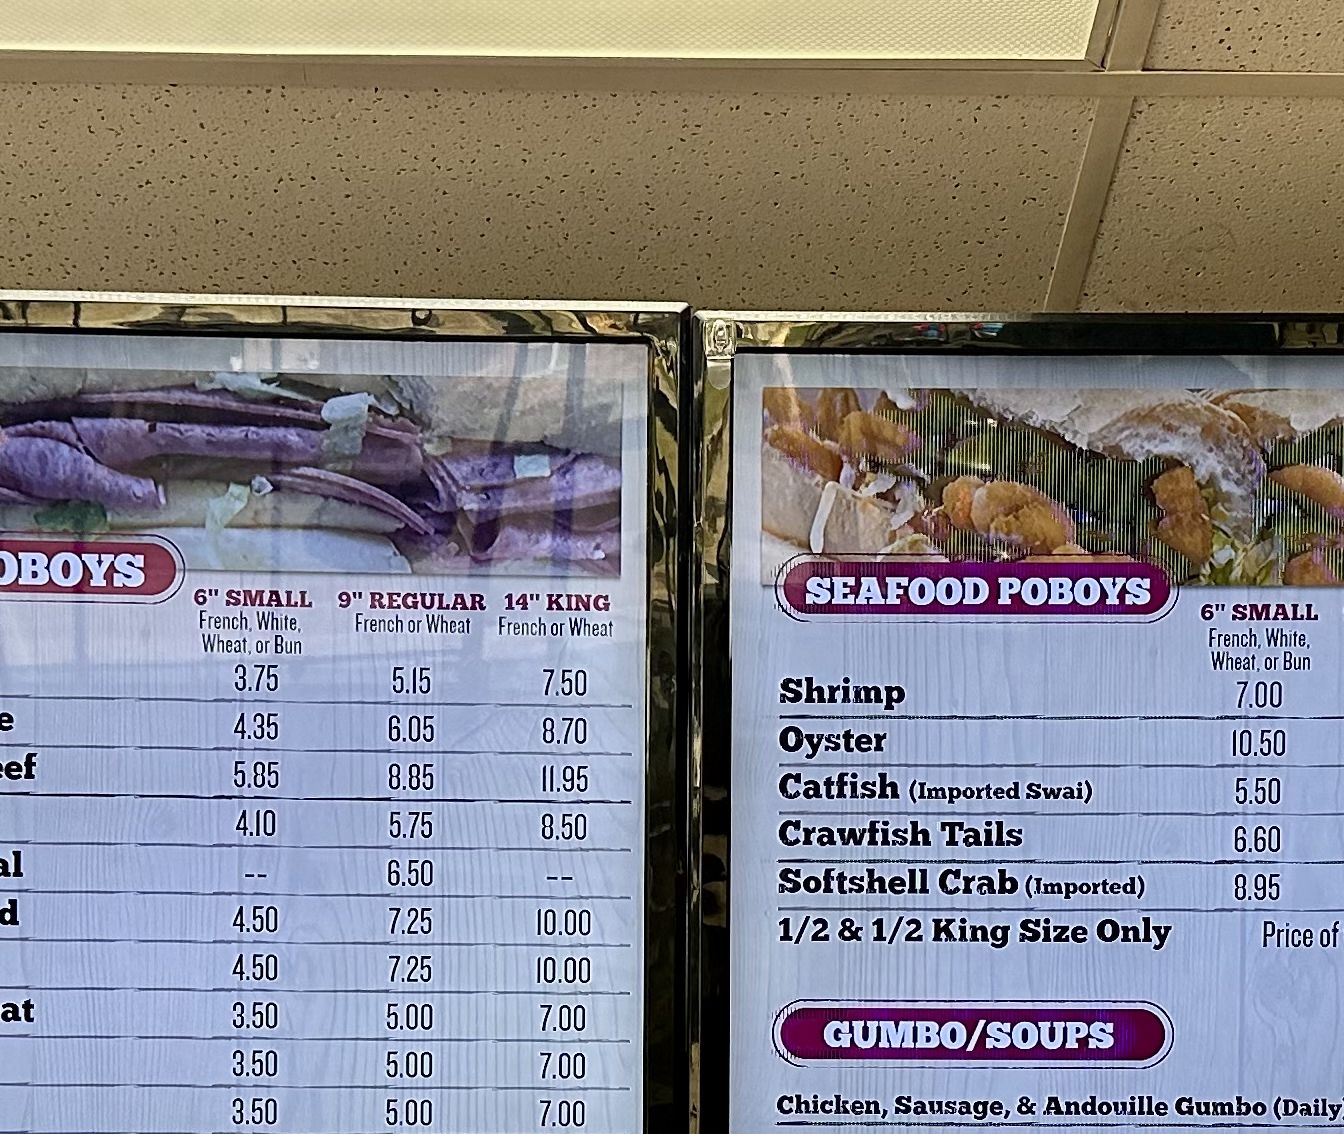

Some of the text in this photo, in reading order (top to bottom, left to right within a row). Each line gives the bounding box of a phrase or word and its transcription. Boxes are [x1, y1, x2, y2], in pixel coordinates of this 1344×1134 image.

[805, 576, 1151, 606] SEAFOOD POBOYS
[778, 772, 900, 800] Catfish
[908, 779, 1021, 805] (Imported
[1025, 779, 1093, 805] Swai)
[1235, 777, 1281, 805] 5.50
[235, 809, 276, 837] 4.10
[389, 811, 433, 839] 5.75
[541, 813, 587, 841] 8.50
[387, 859, 434, 887] 6.50
[778, 915, 830, 945] 1/2
[837, 917, 864, 942] &
[871, 915, 924, 945] 1/2
[931, 917, 1011, 949] King
[1018, 917, 1088, 944] Size
[1096, 916, 1173, 951] Only
[1262, 920, 1314, 948] Price
[1319, 920, 1340, 948] of
[823, 1019, 1115, 1052] GUMBO/SOUPS
[232, 1097, 278, 1125] 3.50
[385, 1098, 433, 1126] 5.00
[539, 1099, 585, 1127] 7.00
[776, 1094, 888, 1120] Chicken,
[894, 1095, 1011, 1121] Sausage,
[1016, 1096, 1037, 1116] &
[1042, 1095, 1169, 1117] Andouille
[1174, 1095, 1267, 1116] Gumbo
